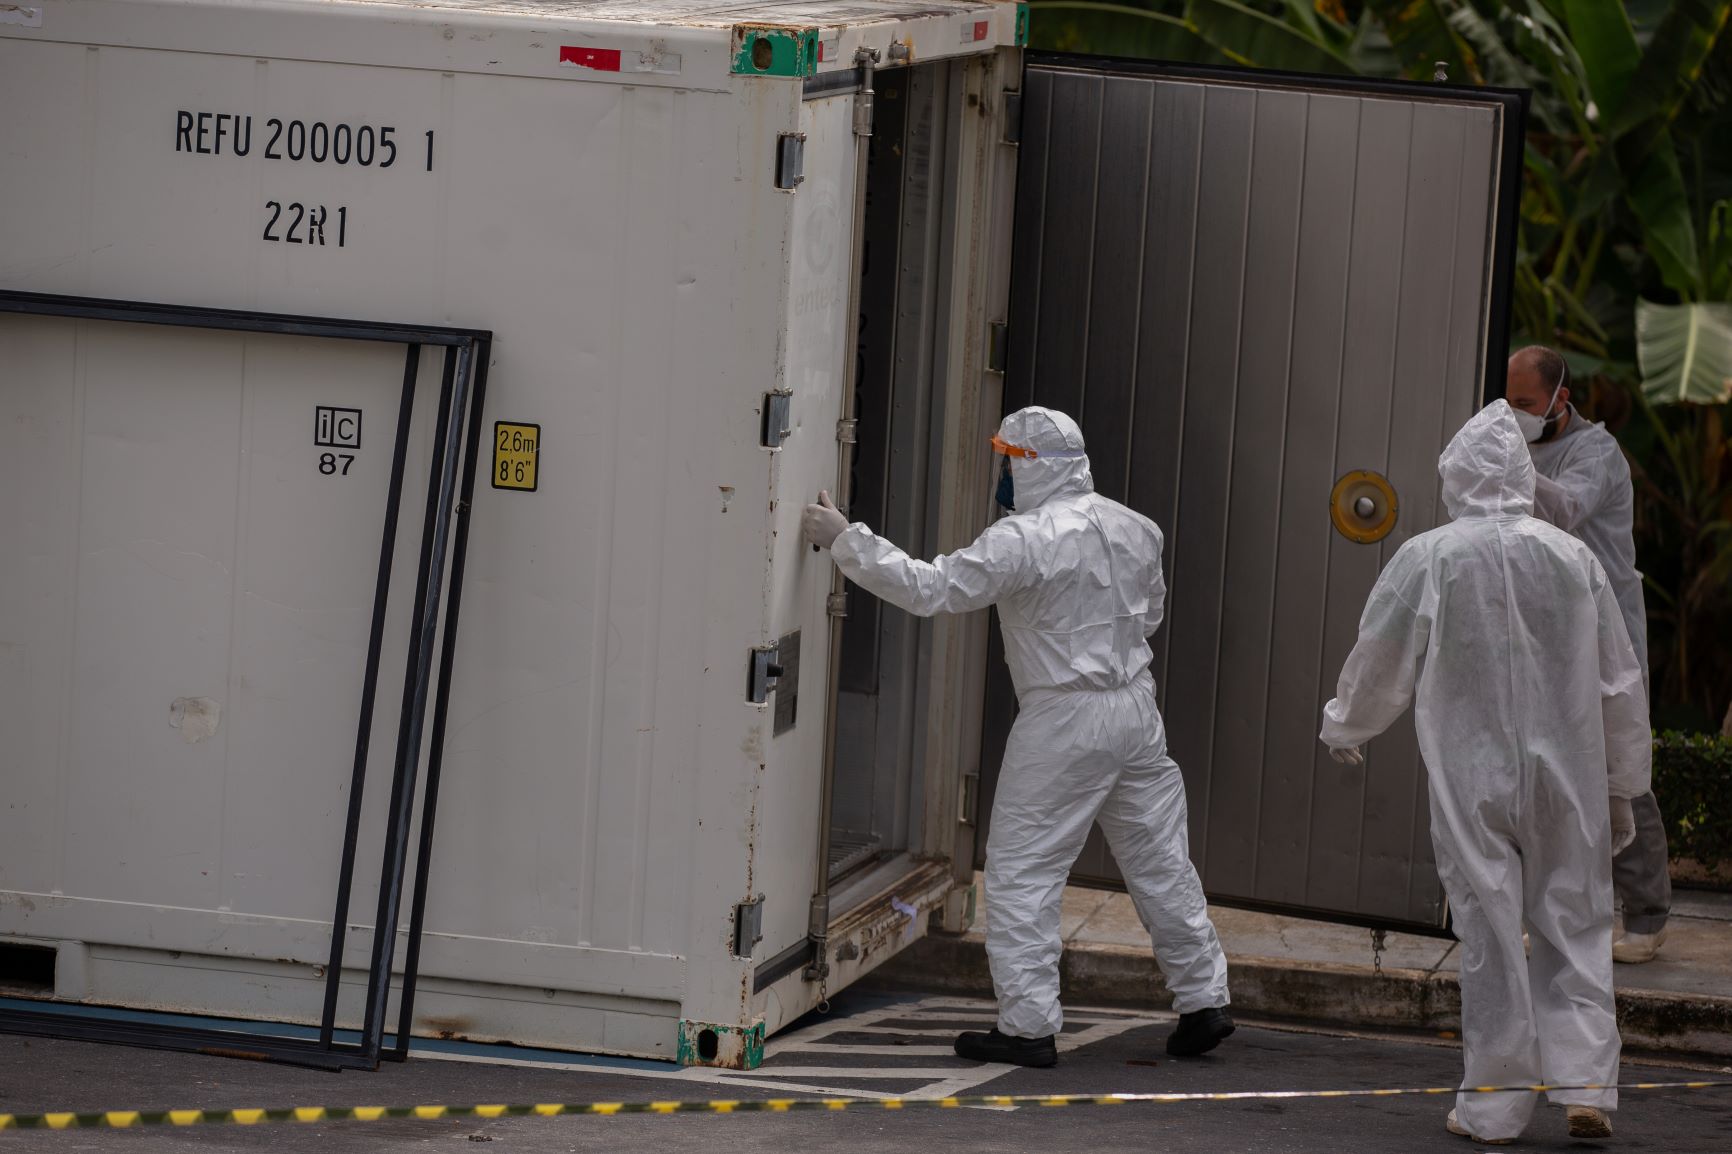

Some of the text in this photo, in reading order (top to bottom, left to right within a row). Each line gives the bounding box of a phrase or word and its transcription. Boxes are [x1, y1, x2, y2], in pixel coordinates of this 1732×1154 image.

[175, 110, 434, 172] REFU 200005 1
[263, 200, 347, 248] 22R1
[318, 452, 355, 476] 87
